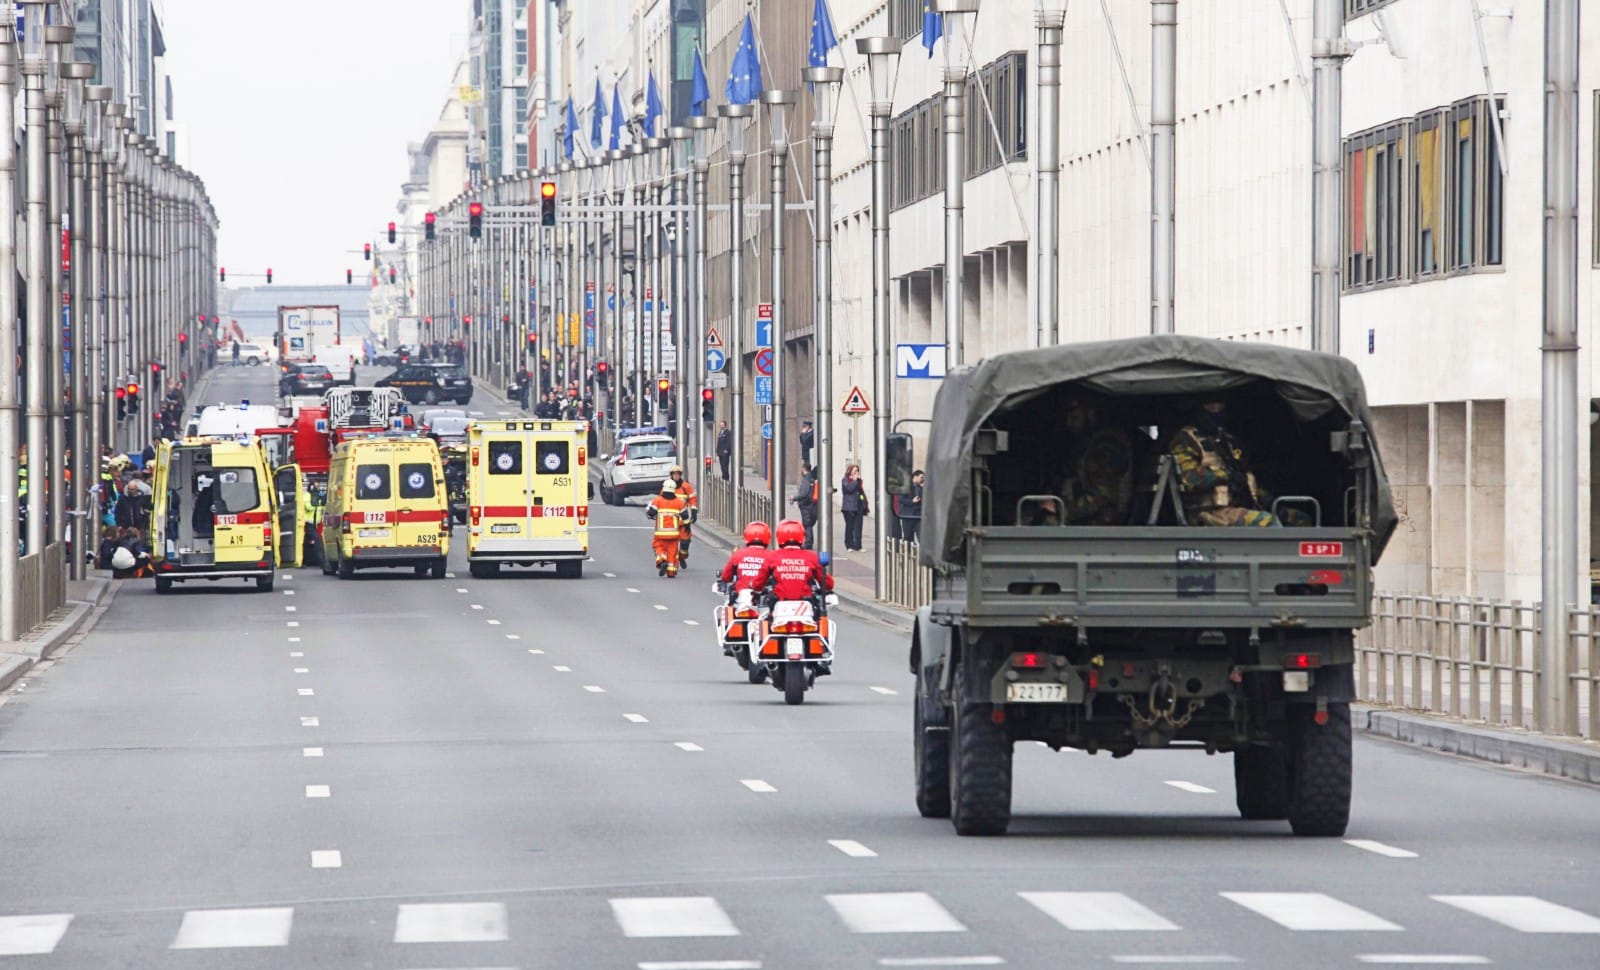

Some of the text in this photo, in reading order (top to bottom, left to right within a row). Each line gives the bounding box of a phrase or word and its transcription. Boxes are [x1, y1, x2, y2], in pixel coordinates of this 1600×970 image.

[897, 345, 946, 377] M
[553, 477, 572, 487] AS31
[370, 513, 385, 521] 112
[549, 507, 566, 517] 112
[223, 516, 236, 525] 112
[417, 534, 437, 544] AS29
[776, 565, 809, 573] MILITAIRE
[780, 572, 805, 580] POLITIE
[1020, 685, 1061, 699] 22177
